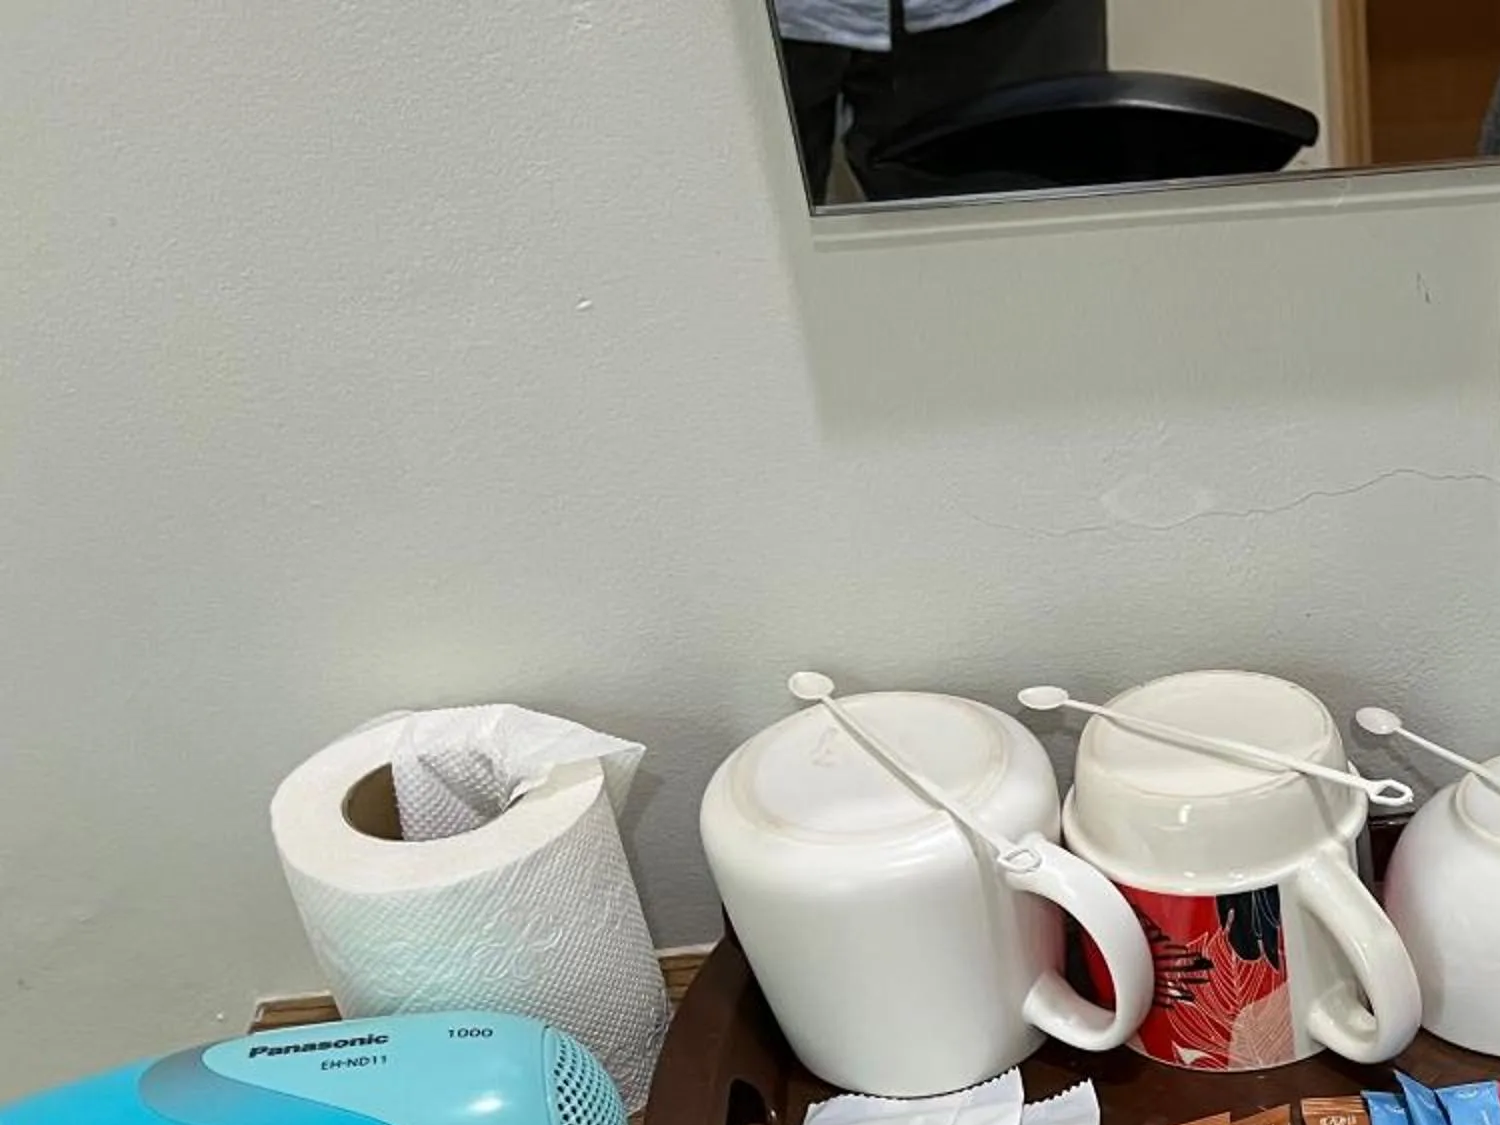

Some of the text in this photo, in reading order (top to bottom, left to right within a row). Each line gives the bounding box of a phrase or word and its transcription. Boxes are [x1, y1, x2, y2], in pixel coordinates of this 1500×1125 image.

[448, 1028, 494, 1039] 1000
[248, 1033, 390, 1058] Panasonic
[321, 1055, 388, 1071] EH-ND11
